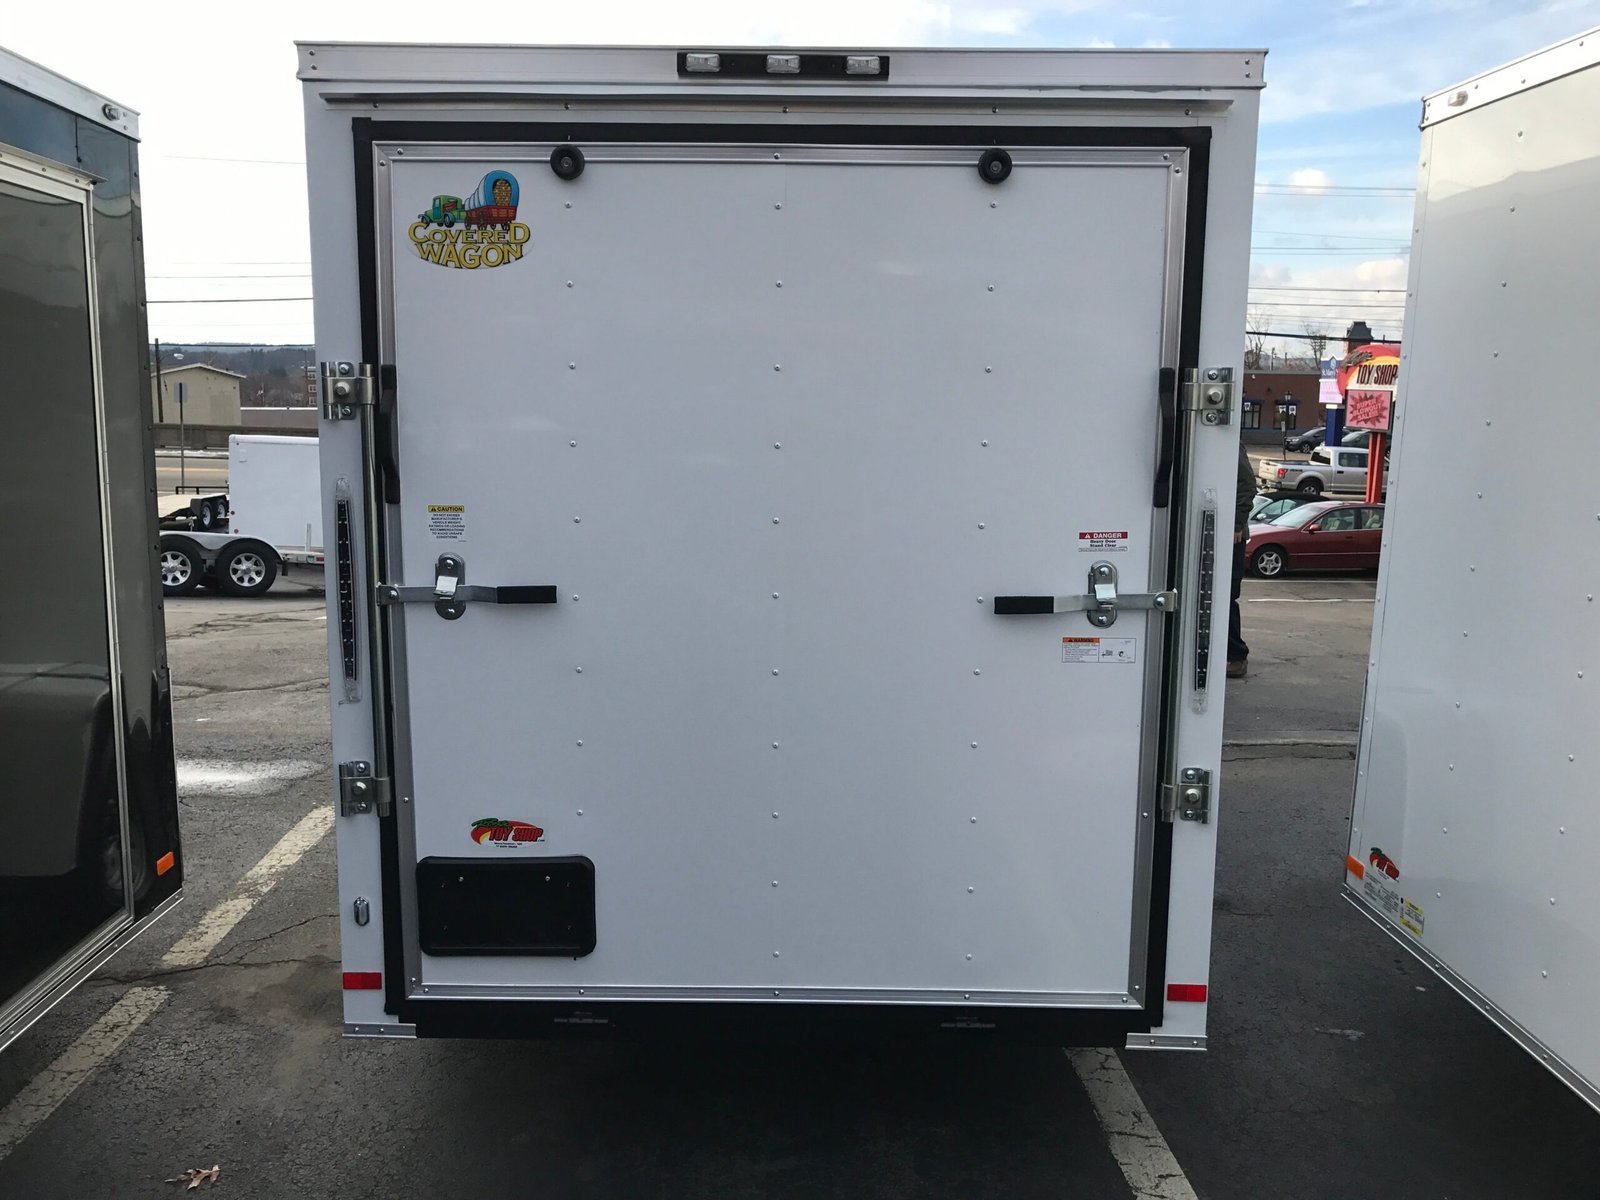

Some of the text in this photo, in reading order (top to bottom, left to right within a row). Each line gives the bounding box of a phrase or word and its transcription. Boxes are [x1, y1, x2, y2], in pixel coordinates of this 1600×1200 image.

[408, 221, 531, 245] COVERED
[414, 243, 524, 269] WAGON
[1356, 363, 1399, 386] TOY SHOP
[488, 826, 513, 842] TOY
[511, 827, 544, 842] SHOP
